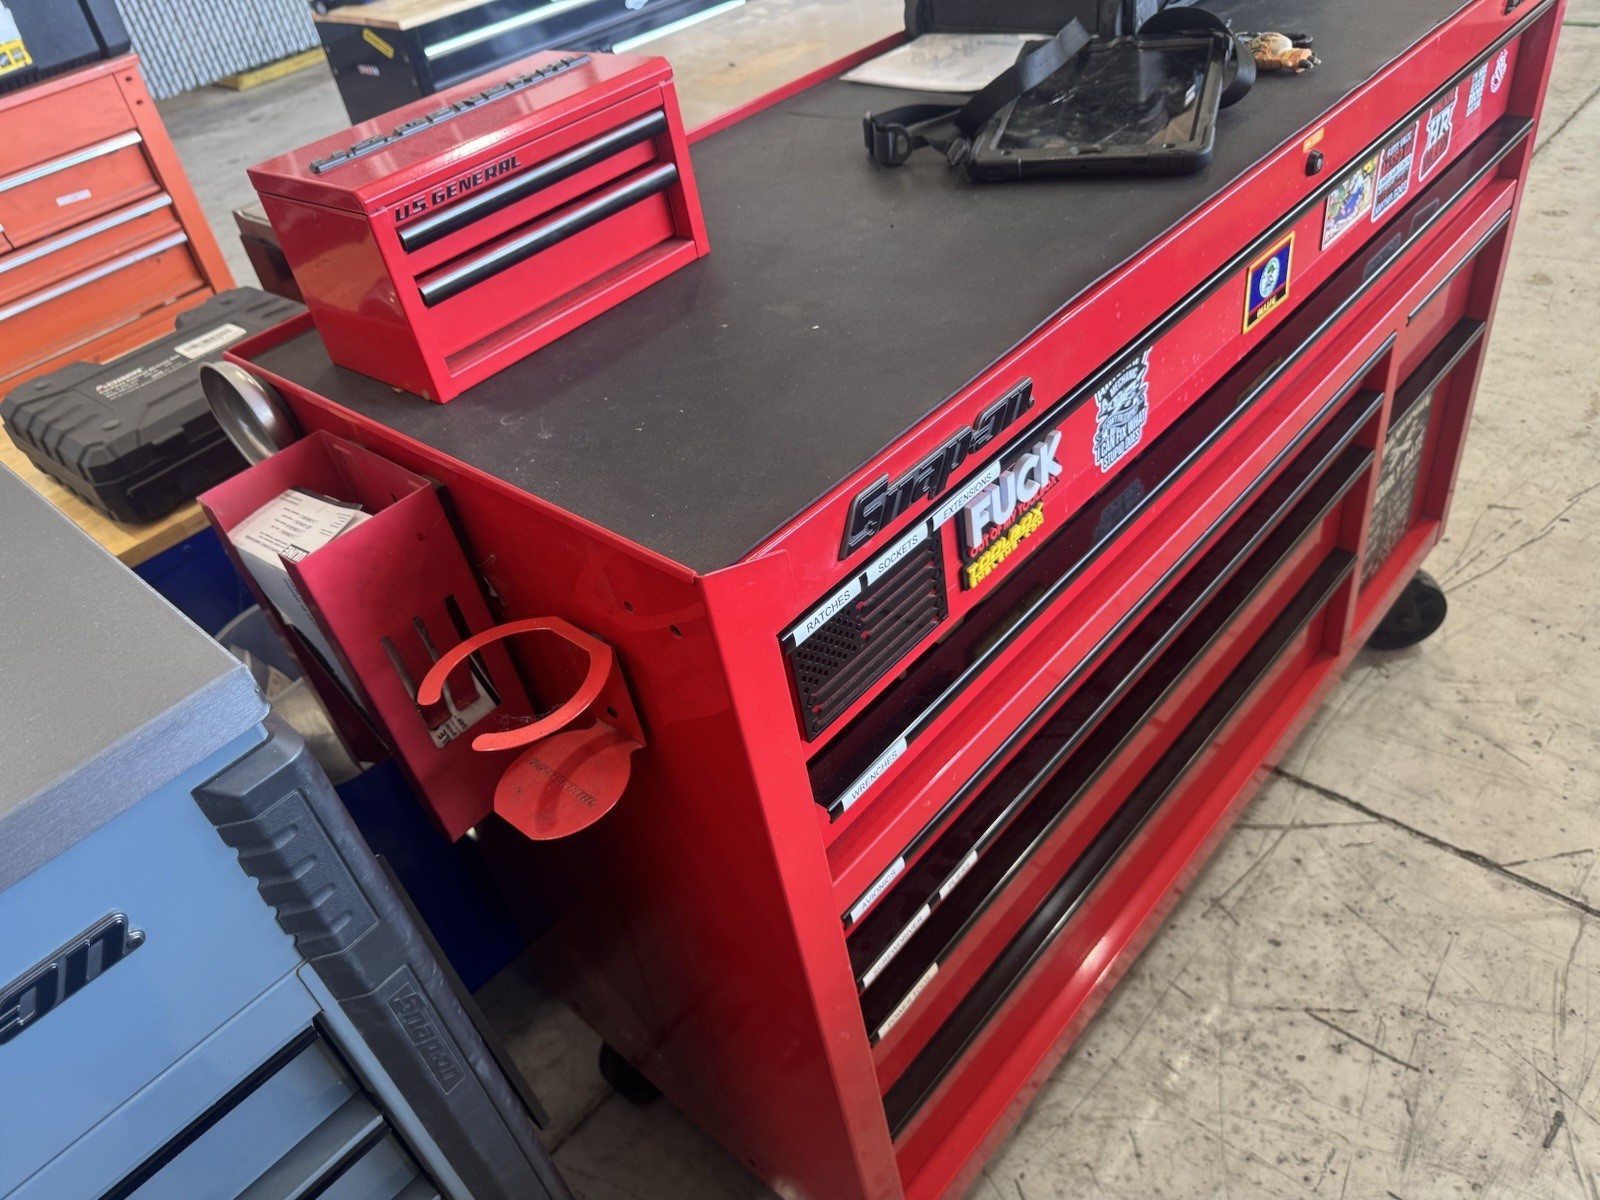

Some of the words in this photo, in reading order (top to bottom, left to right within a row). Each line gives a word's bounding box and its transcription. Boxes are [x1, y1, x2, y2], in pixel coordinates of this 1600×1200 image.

[394, 195, 429, 222] U.S.
[431, 156, 521, 206] GENERAL
[838, 377, 1035, 561] Snap-on
[1101, 436, 1116, 458] CAN
[1102, 440, 1124, 470] STUPID
[943, 473, 993, 520] EXTENSIONS
[964, 429, 1063, 549] FUCK
[878, 534, 919, 573] SOCKETS
[967, 501, 1043, 576] TOOLBOX
[970, 536, 989, 558] OUT
[806, 590, 851, 634] RATCHES
[851, 750, 898, 799] WRENCHES
[862, 869, 896, 909] AVIONICS
[947, 862, 970, 888] PLIERS
[873, 916, 922, 975] SCREWDRIVER
[887, 997, 911, 1027] POWER
